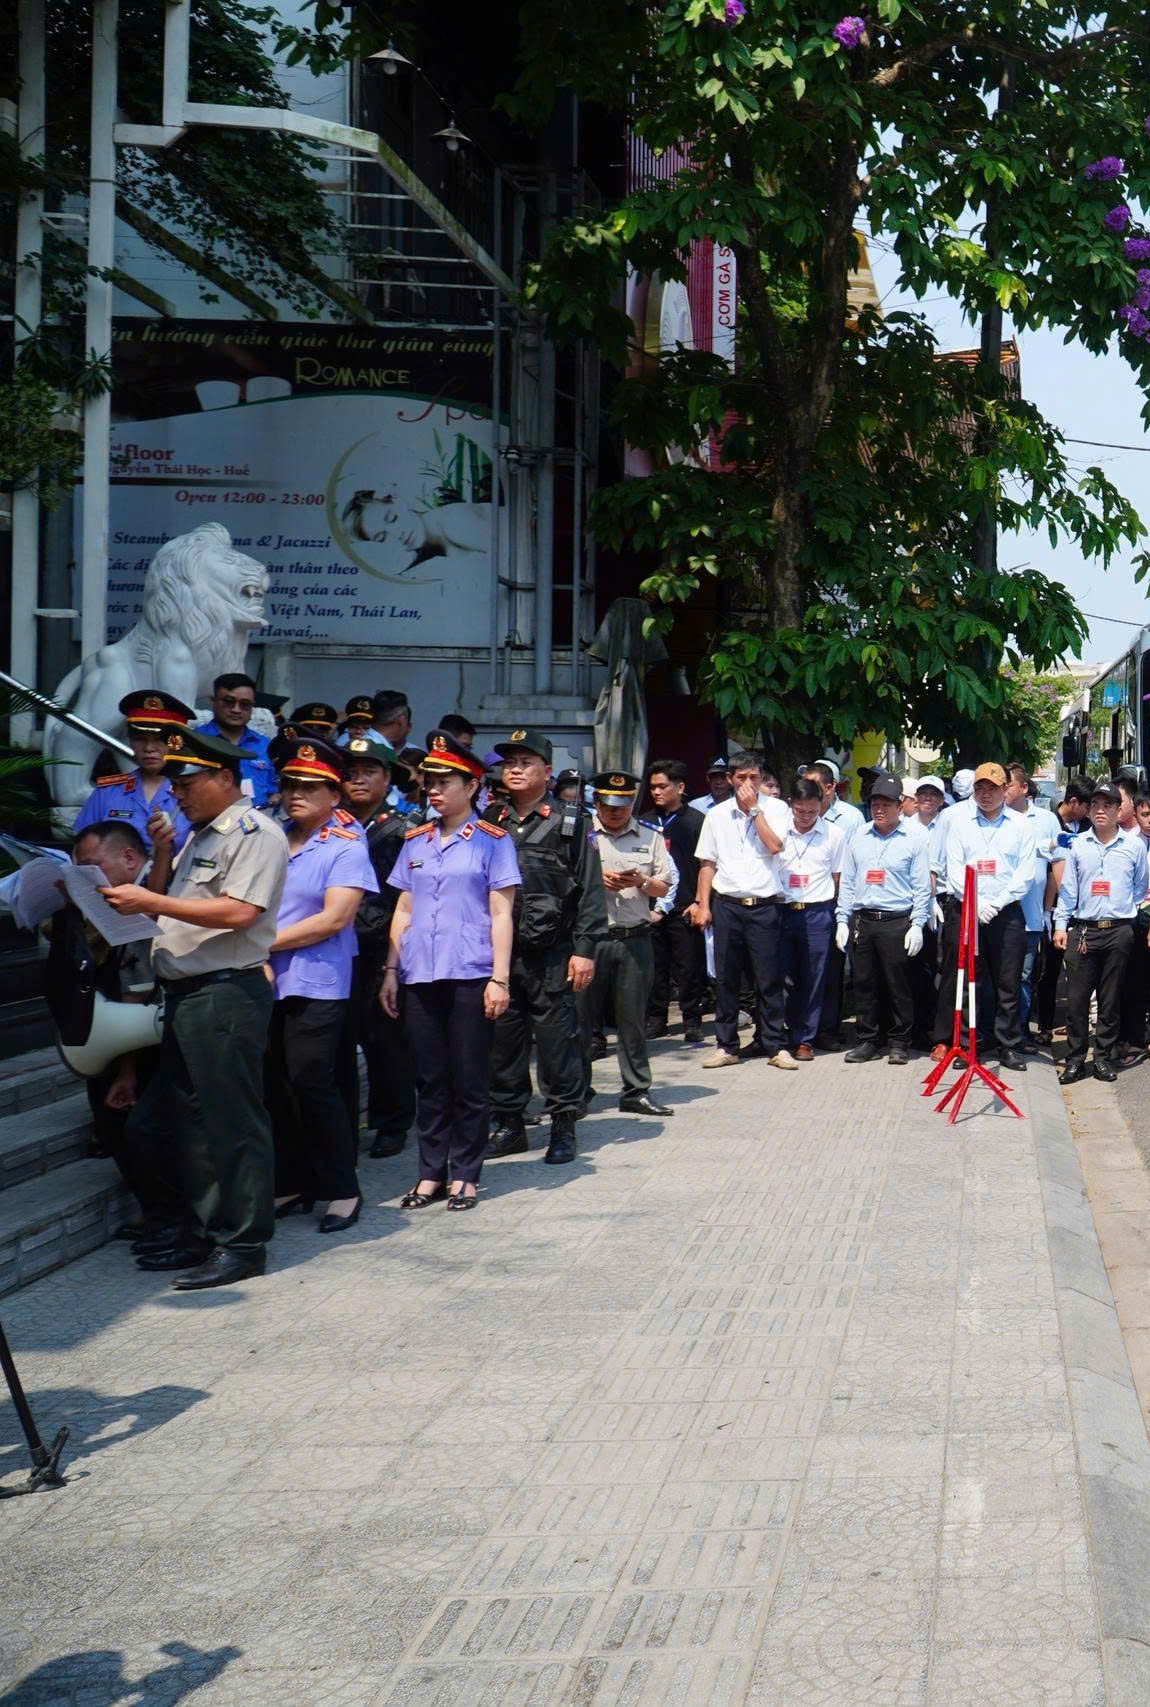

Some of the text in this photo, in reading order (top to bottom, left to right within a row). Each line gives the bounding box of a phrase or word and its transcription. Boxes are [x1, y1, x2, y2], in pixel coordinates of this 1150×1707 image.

[716, 263, 731, 285] GÀ
[125, 443, 175, 461] floor
[175, 489, 217, 506] Open
[223, 491, 265, 504] 12:00
[281, 492, 326, 506] 23:00
[257, 535, 272, 547] &
[275, 535, 332, 550] Jacuzzi
[288, 561, 322, 575] thân
[327, 562, 359, 576] theo
[270, 602, 300, 620] Việt
[303, 603, 345, 620] Nam,
[351, 604, 386, 618] Thái
[390, 605, 423, 621] Lan,
